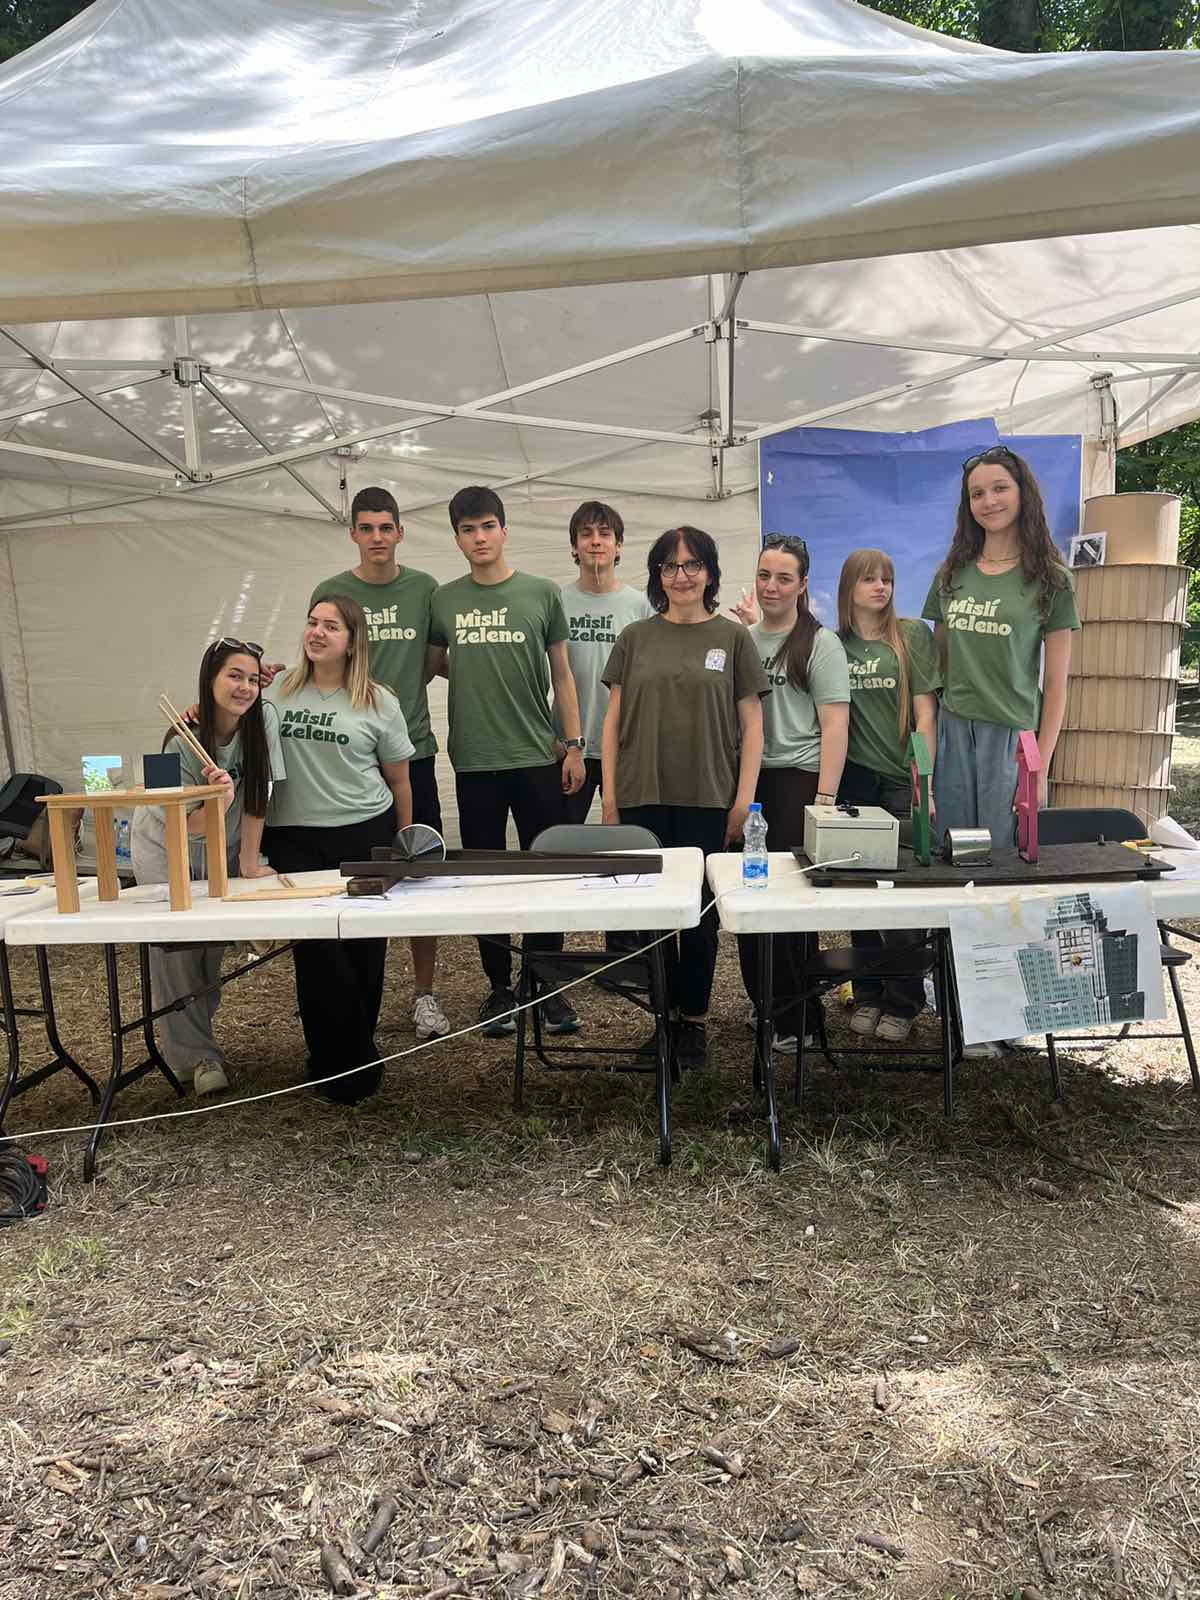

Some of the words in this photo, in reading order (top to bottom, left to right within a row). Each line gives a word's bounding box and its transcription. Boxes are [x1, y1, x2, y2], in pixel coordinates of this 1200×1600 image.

[947, 613, 1013, 636] Zeleno
[455, 626, 526, 645] Zeleno
[569, 629, 623, 644] Zelen
[848, 675, 897, 690] eleno
[280, 723, 350, 745] Zeleno
